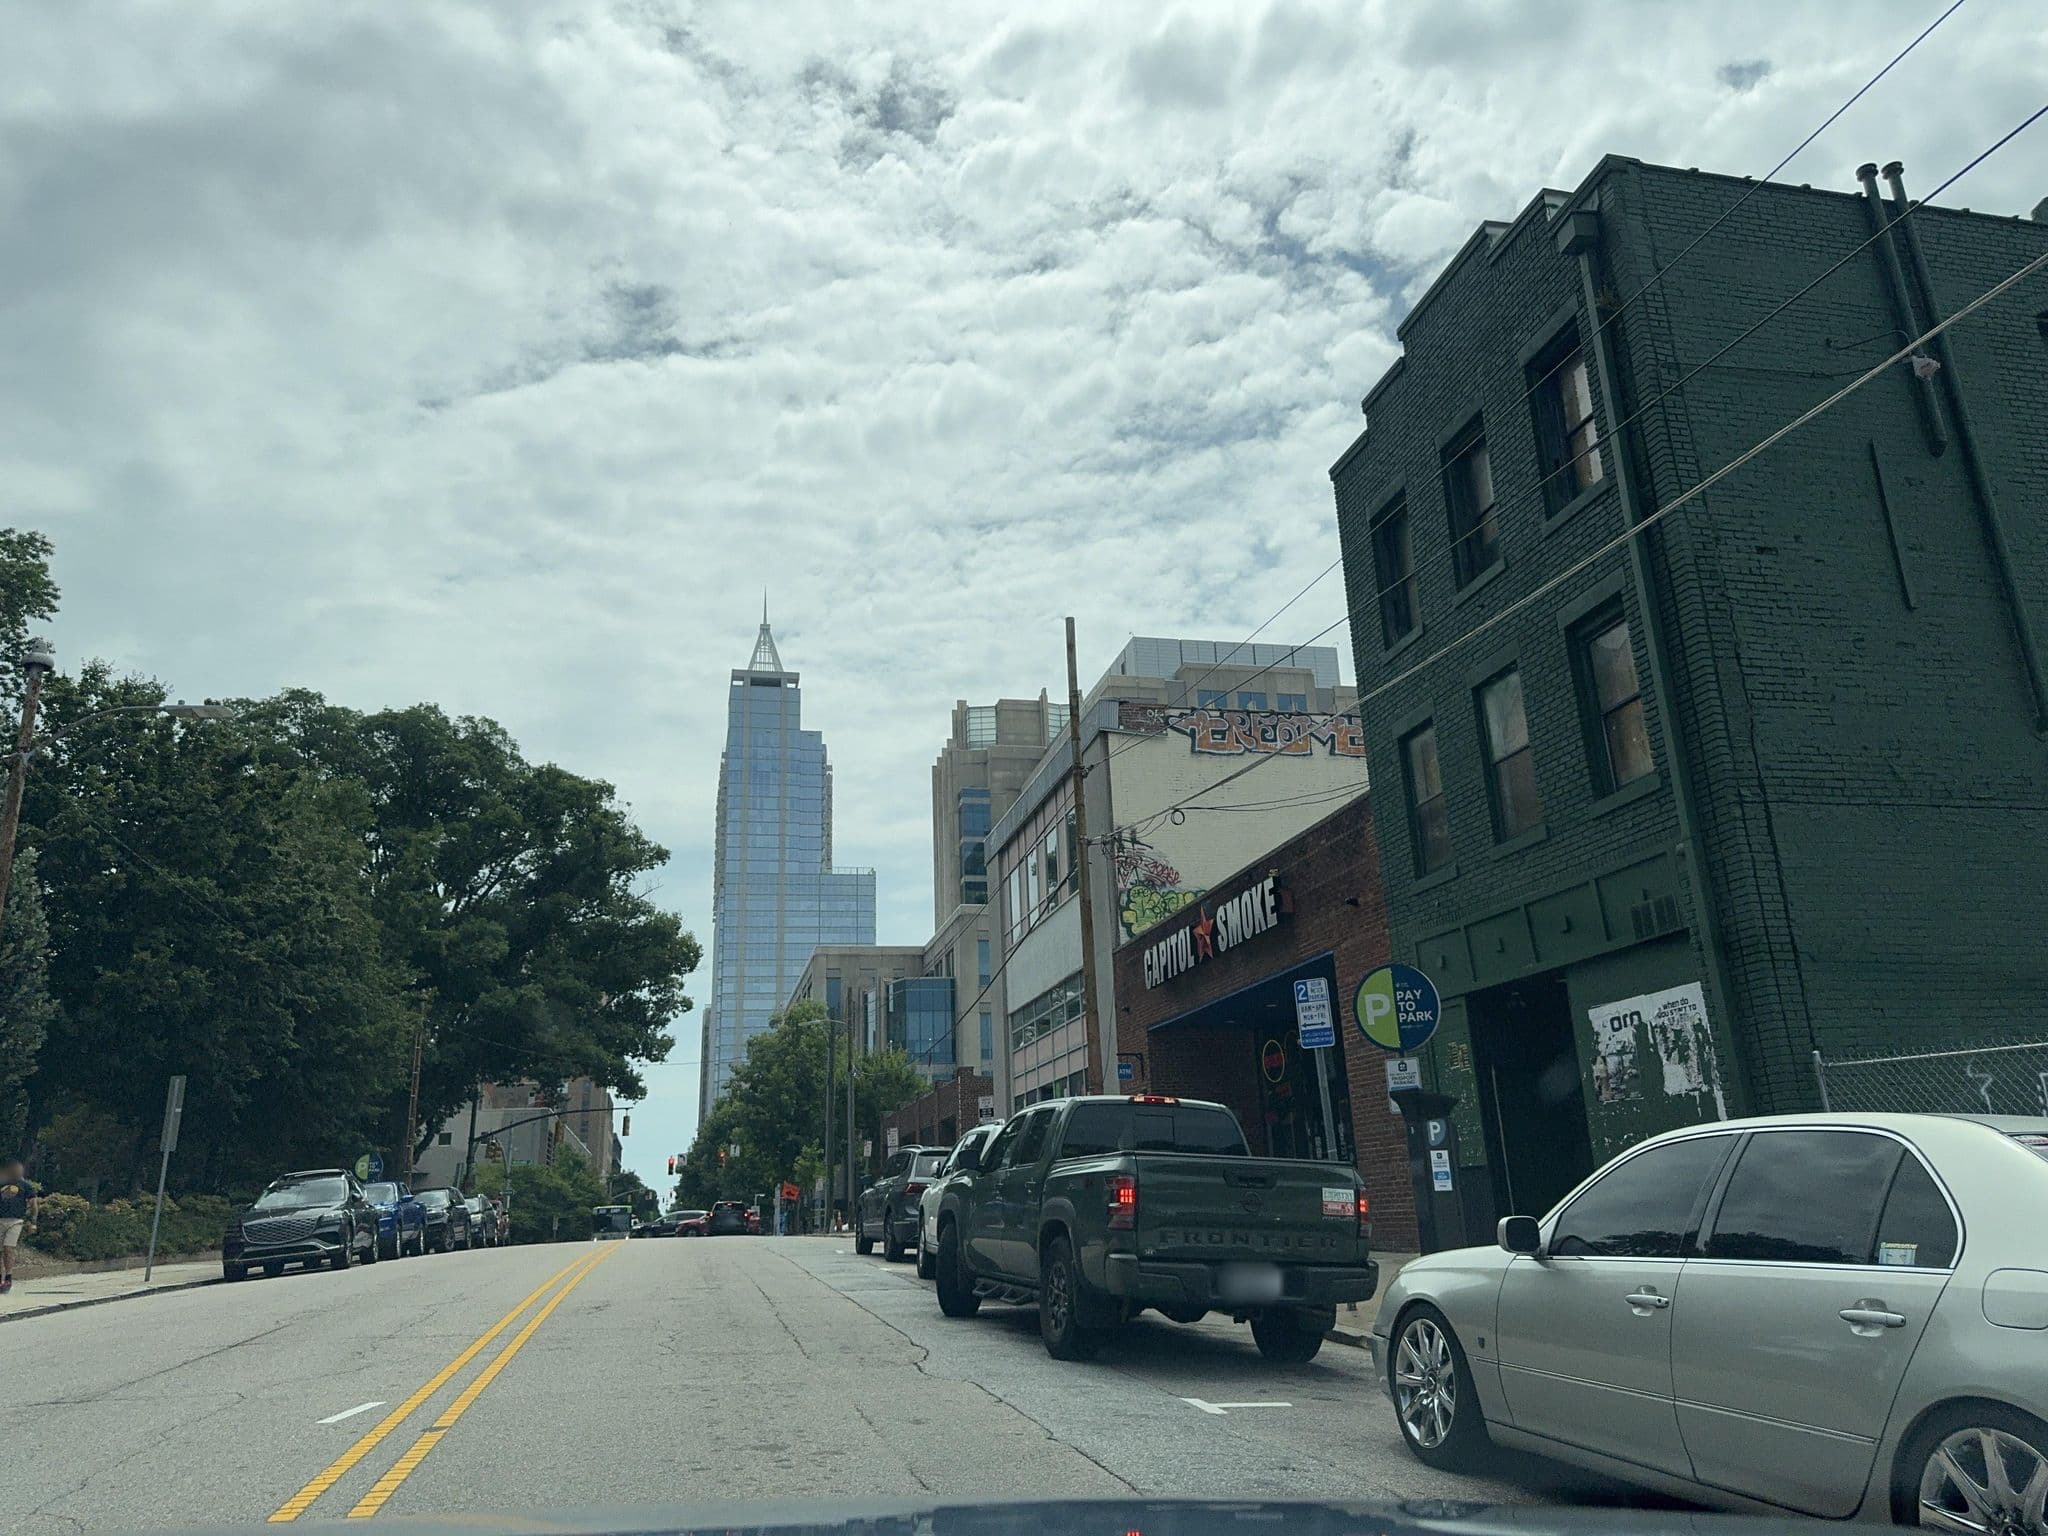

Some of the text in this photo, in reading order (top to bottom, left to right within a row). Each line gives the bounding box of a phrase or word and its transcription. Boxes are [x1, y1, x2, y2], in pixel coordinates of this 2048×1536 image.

[1144, 926, 1195, 990] CAPITOL
[1216, 876, 1278, 952] SMOKE
[1297, 984, 1308, 1000] 2
[1396, 989, 1422, 1001] PAY
[1364, 993, 1391, 1025] P
[1398, 1001, 1416, 1012] TO
[1399, 1010, 1433, 1023] PARK
[1430, 1121, 1441, 1141] P
[1159, 1230, 1337, 1248] FRONTIER
